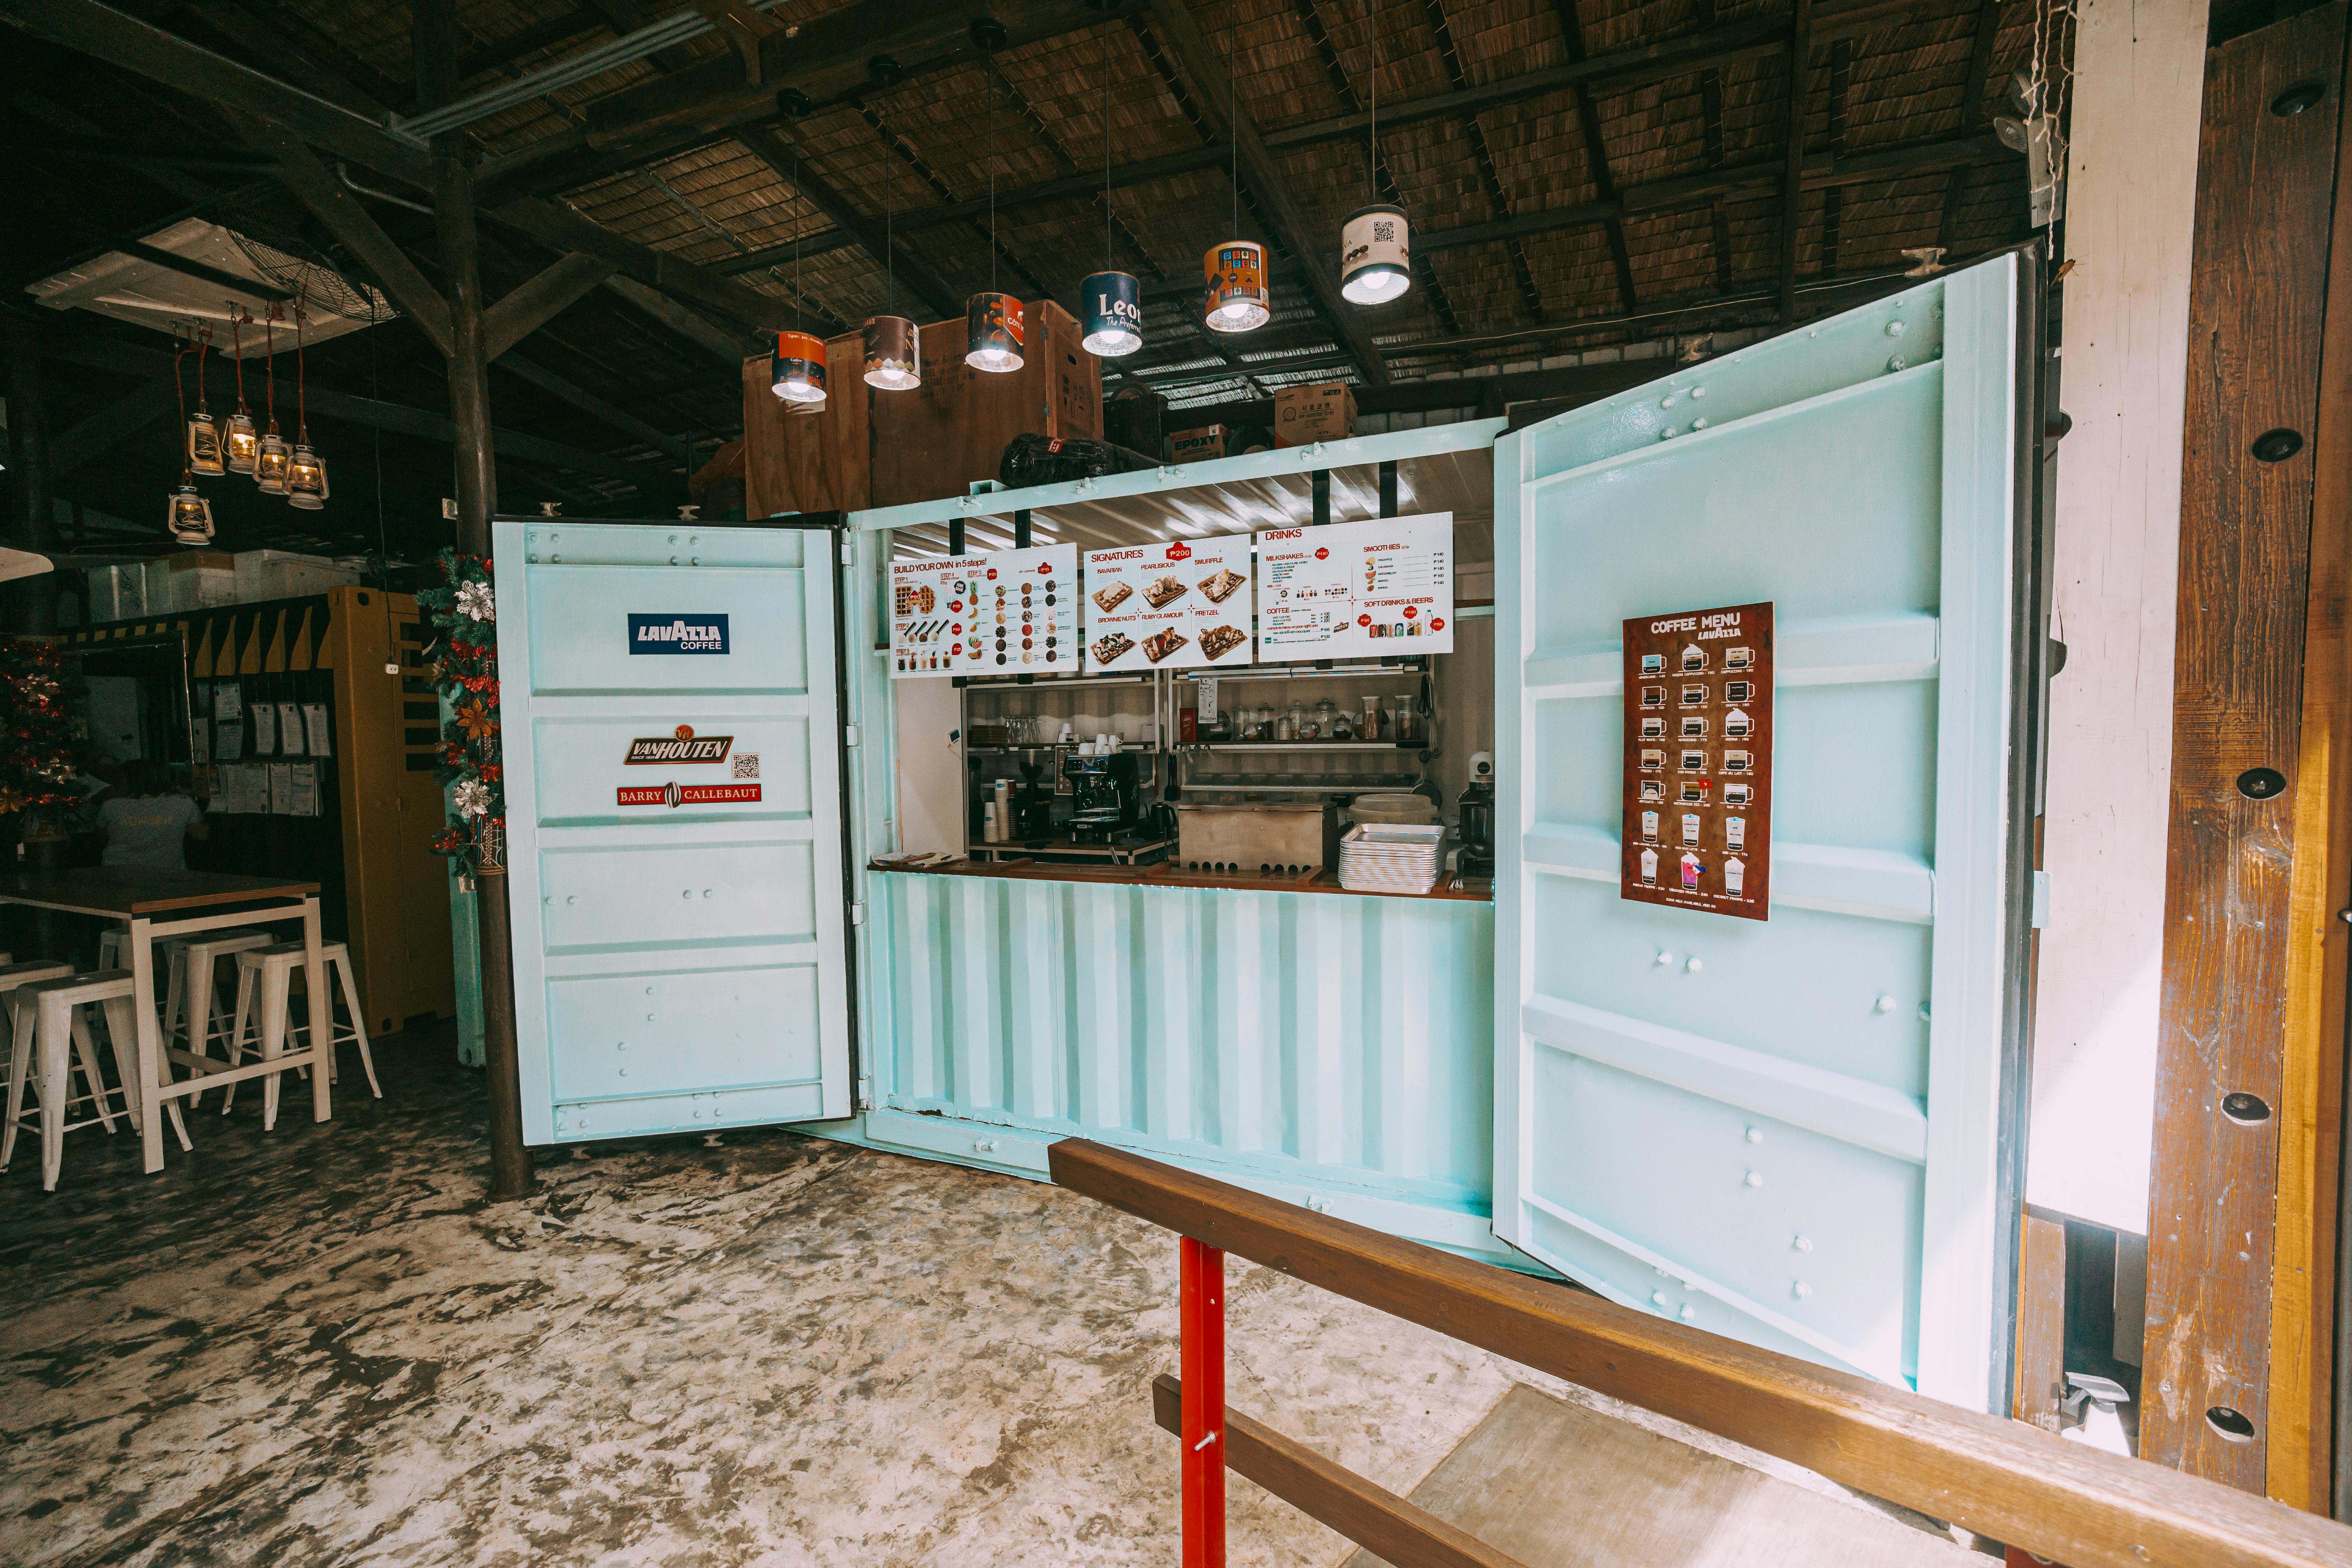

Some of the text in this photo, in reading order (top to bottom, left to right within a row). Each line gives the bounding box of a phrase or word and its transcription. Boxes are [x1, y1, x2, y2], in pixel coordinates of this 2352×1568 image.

[1008, 318, 1020, 329] CÔTE
[1107, 316, 1117, 326] The
[1175, 435, 1216, 450] EPOXY
[1265, 528, 1302, 541] DRINKS
[1364, 544, 1400, 552] SMOOTHIES
[1091, 550, 1143, 562] SIGNATURES
[1266, 553, 1303, 561] MILKSHAKES
[894, 565, 914, 573] BUILD
[936, 561, 953, 569] OWN
[967, 558, 987, 568] steps!
[1651, 612, 1740, 634] COFFEE MENU
[637, 621, 721, 641] LAVAZZA
[1698, 627, 1741, 640] LAVAZZA
[681, 641, 722, 650] COFFEE
[620, 789, 757, 801] BARRY CALLEBAUT
